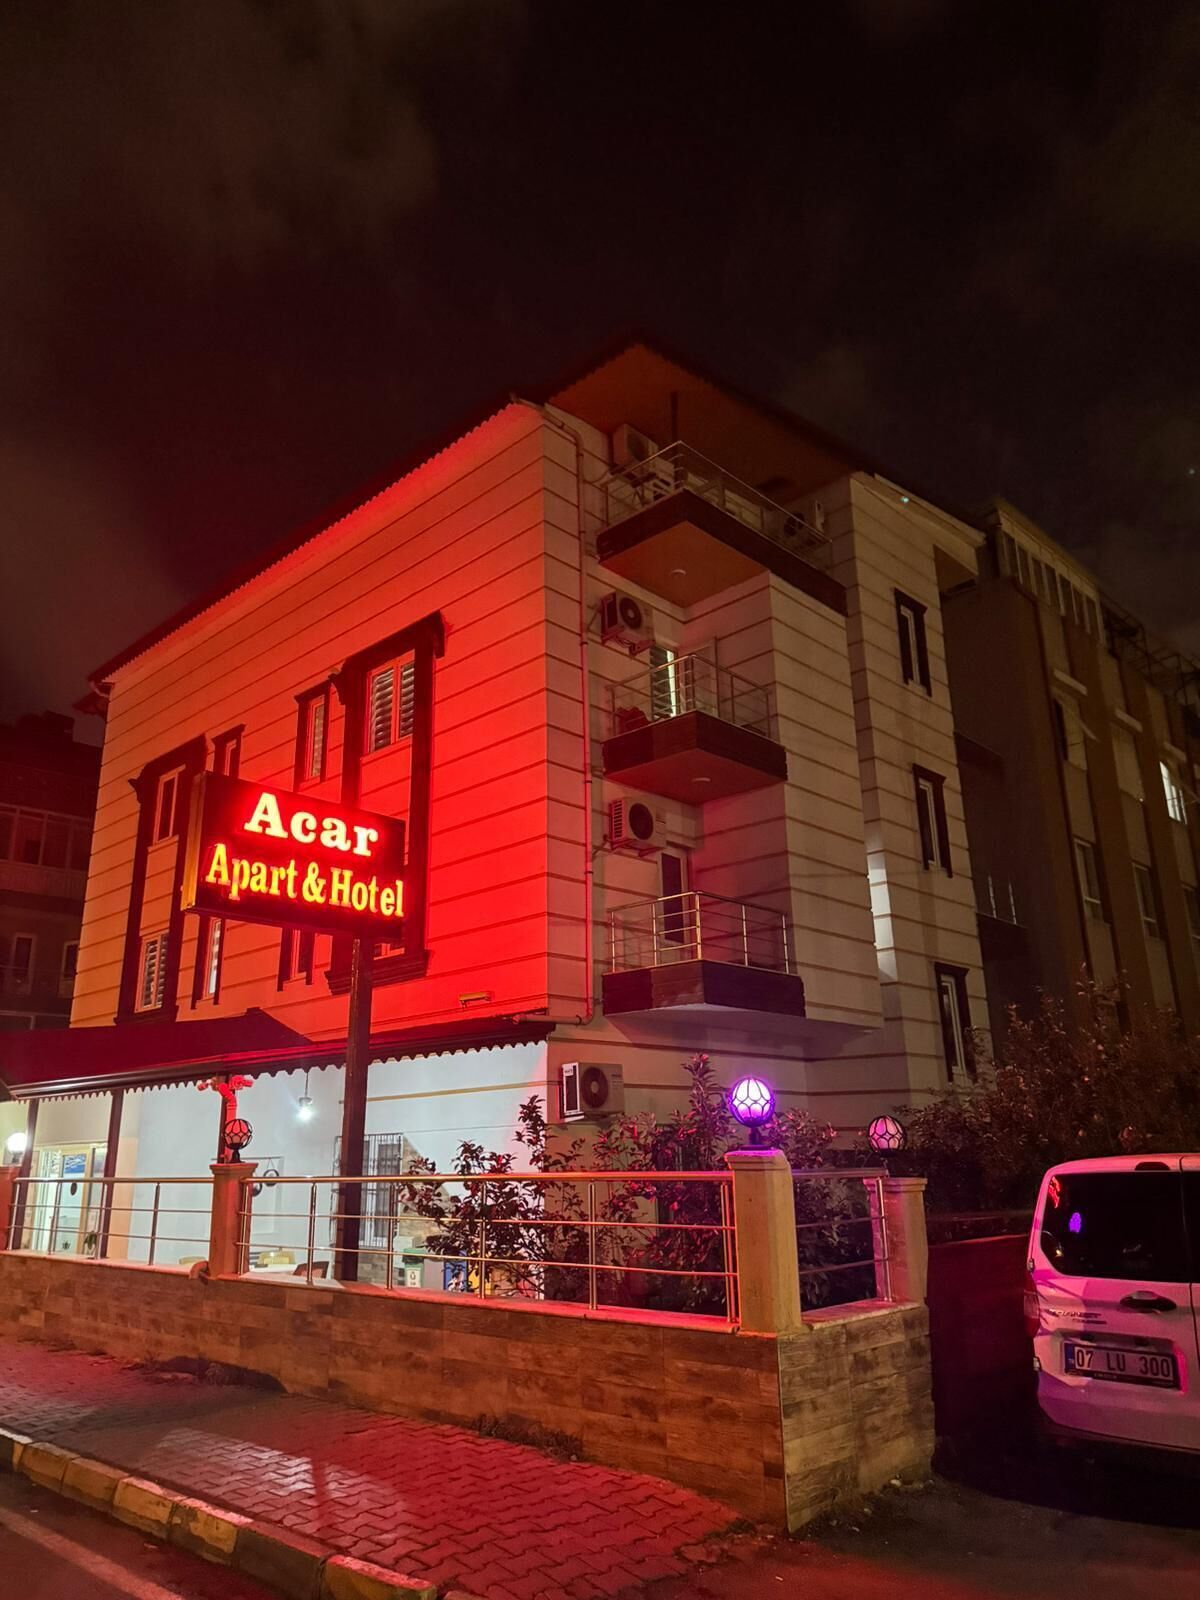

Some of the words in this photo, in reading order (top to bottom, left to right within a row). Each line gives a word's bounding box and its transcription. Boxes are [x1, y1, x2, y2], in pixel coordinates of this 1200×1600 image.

[244, 791, 379, 857] Acar
[205, 843, 298, 901] Apart
[329, 866, 405, 918] Hotel
[1076, 1349, 1094, 1369] 07
[1106, 1352, 1126, 1373] LU
[1139, 1355, 1171, 1378] 300
